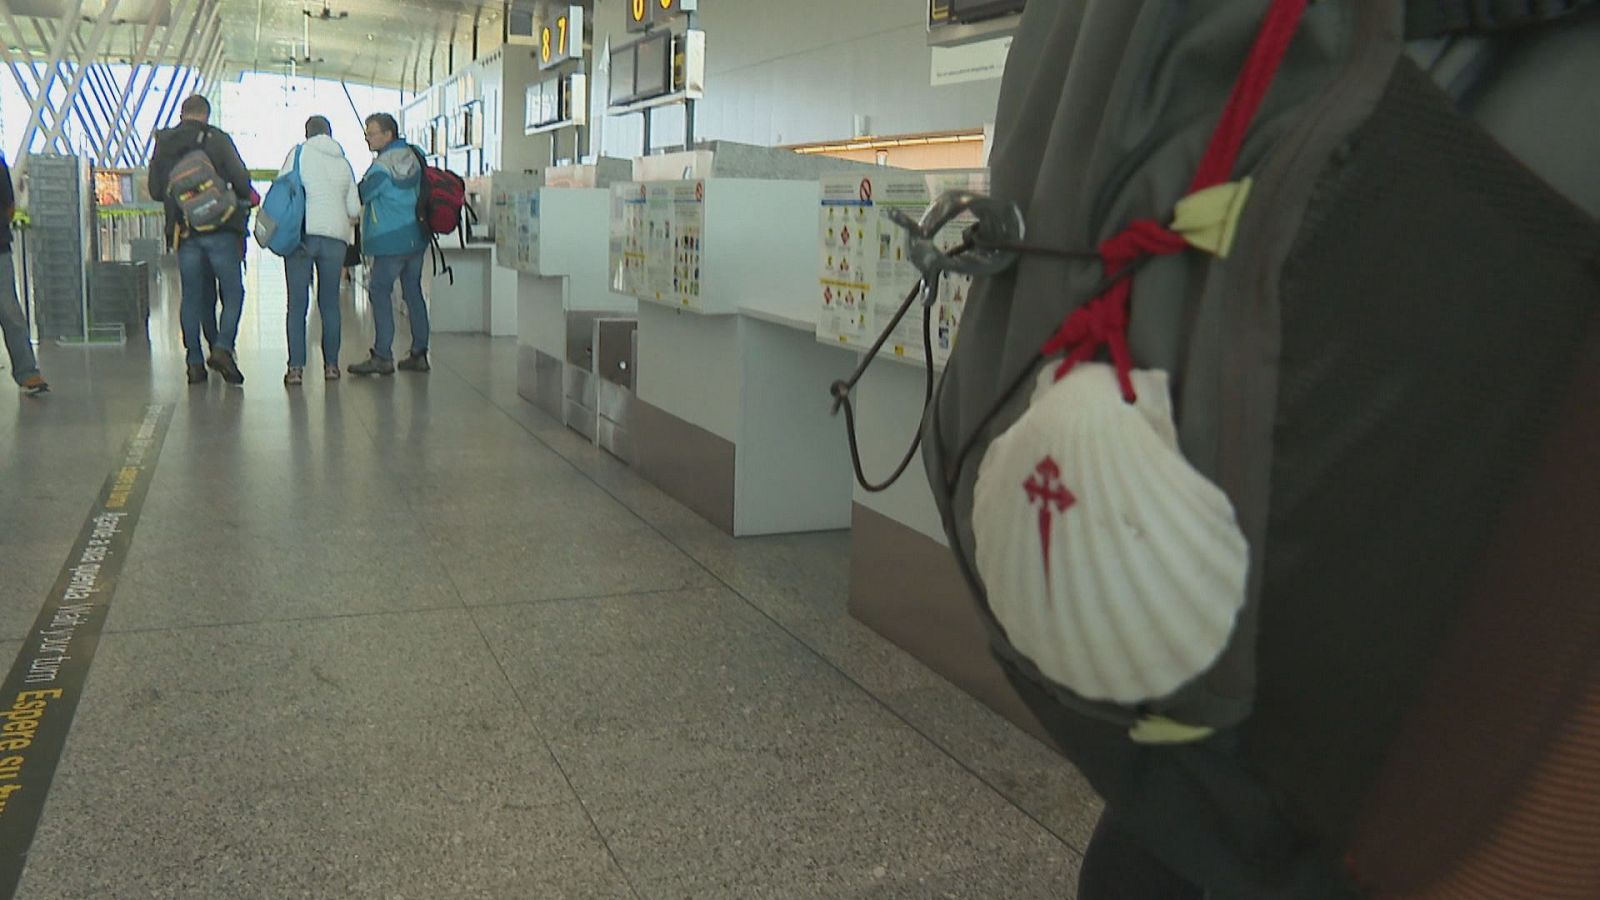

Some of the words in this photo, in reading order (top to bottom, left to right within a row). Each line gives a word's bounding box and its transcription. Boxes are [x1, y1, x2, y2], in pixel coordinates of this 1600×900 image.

[542, 26, 552, 63] 8
[557, 16, 567, 56] 7
[50, 602, 95, 628] Wait
[40, 628, 76, 653] your
[24, 655, 72, 683] turn
[0, 687, 64, 752] Espere
